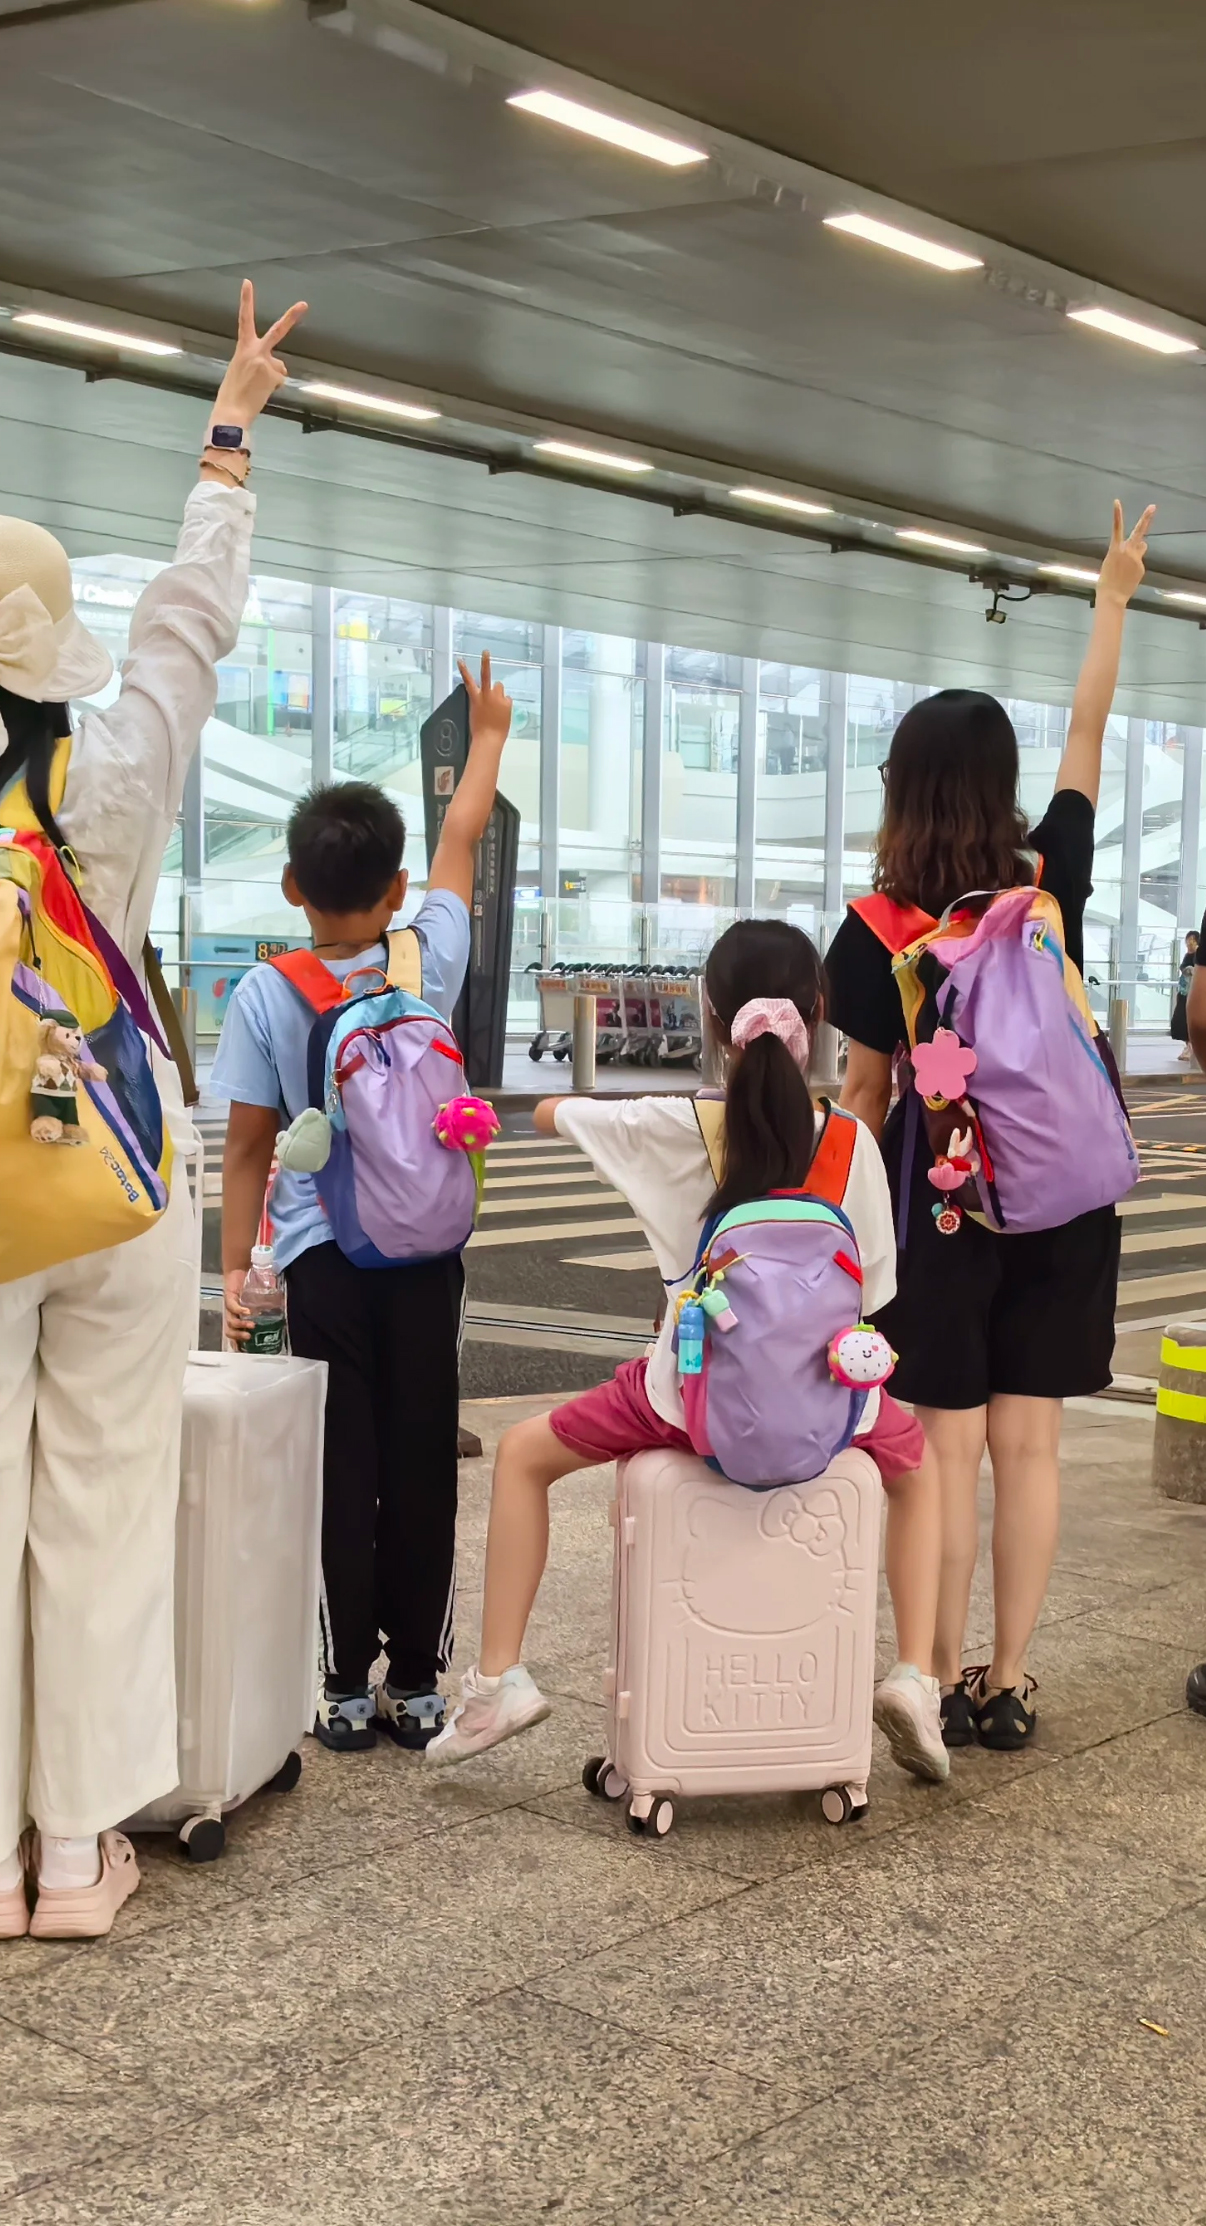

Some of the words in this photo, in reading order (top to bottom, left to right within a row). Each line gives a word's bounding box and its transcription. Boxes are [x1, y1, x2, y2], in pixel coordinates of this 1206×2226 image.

[439, 724, 453, 751] 8
[705, 1650, 818, 1688] HELLO
[703, 1690, 816, 1726] KITTY
